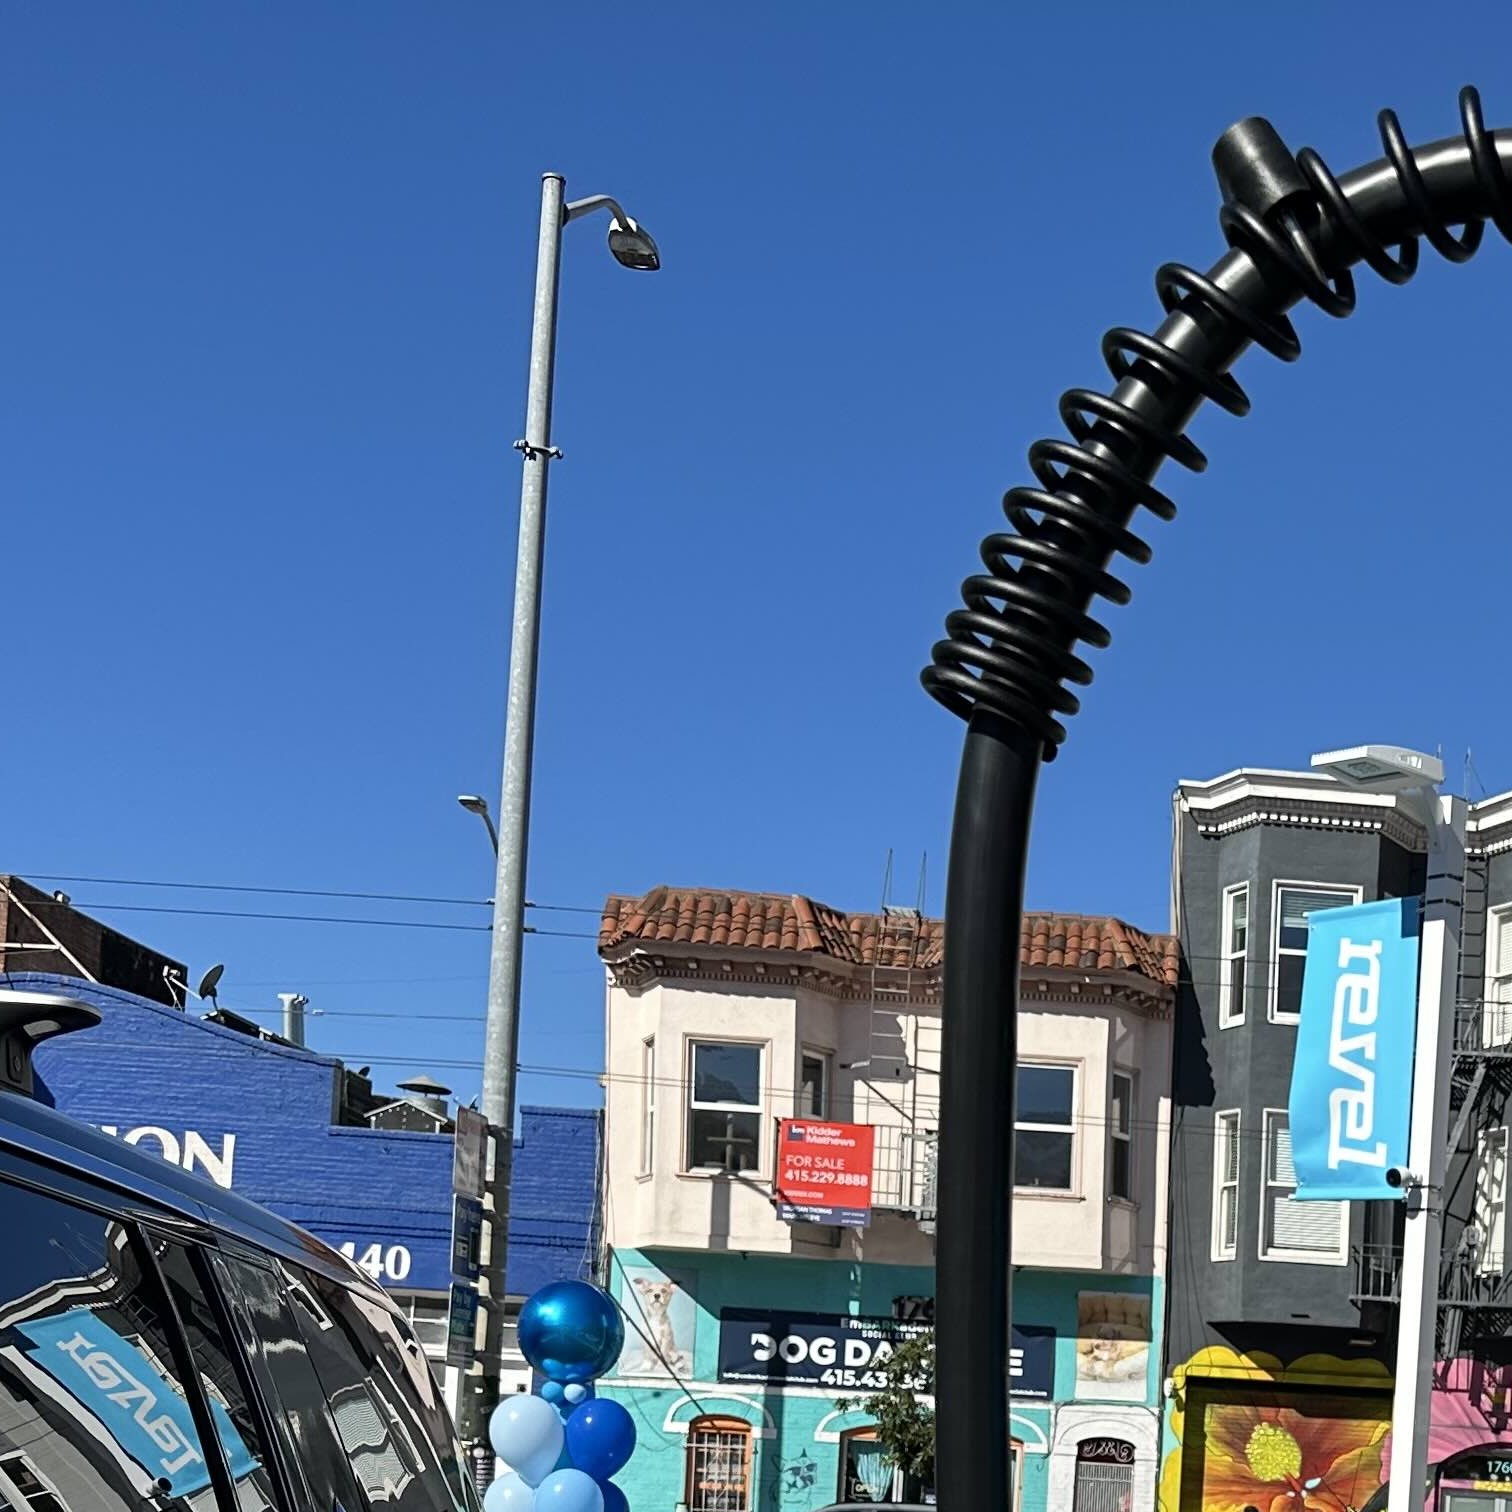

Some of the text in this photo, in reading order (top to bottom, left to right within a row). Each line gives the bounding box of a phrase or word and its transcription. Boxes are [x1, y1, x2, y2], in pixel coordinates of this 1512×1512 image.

[1328, 937, 1387, 1170] revel
[805, 1126, 842, 1137] Kidder
[786, 1155, 845, 1170] FOR SALE
[785, 1169, 868, 1187] 415.229.8888
[751, 1333, 837, 1365] DOG
